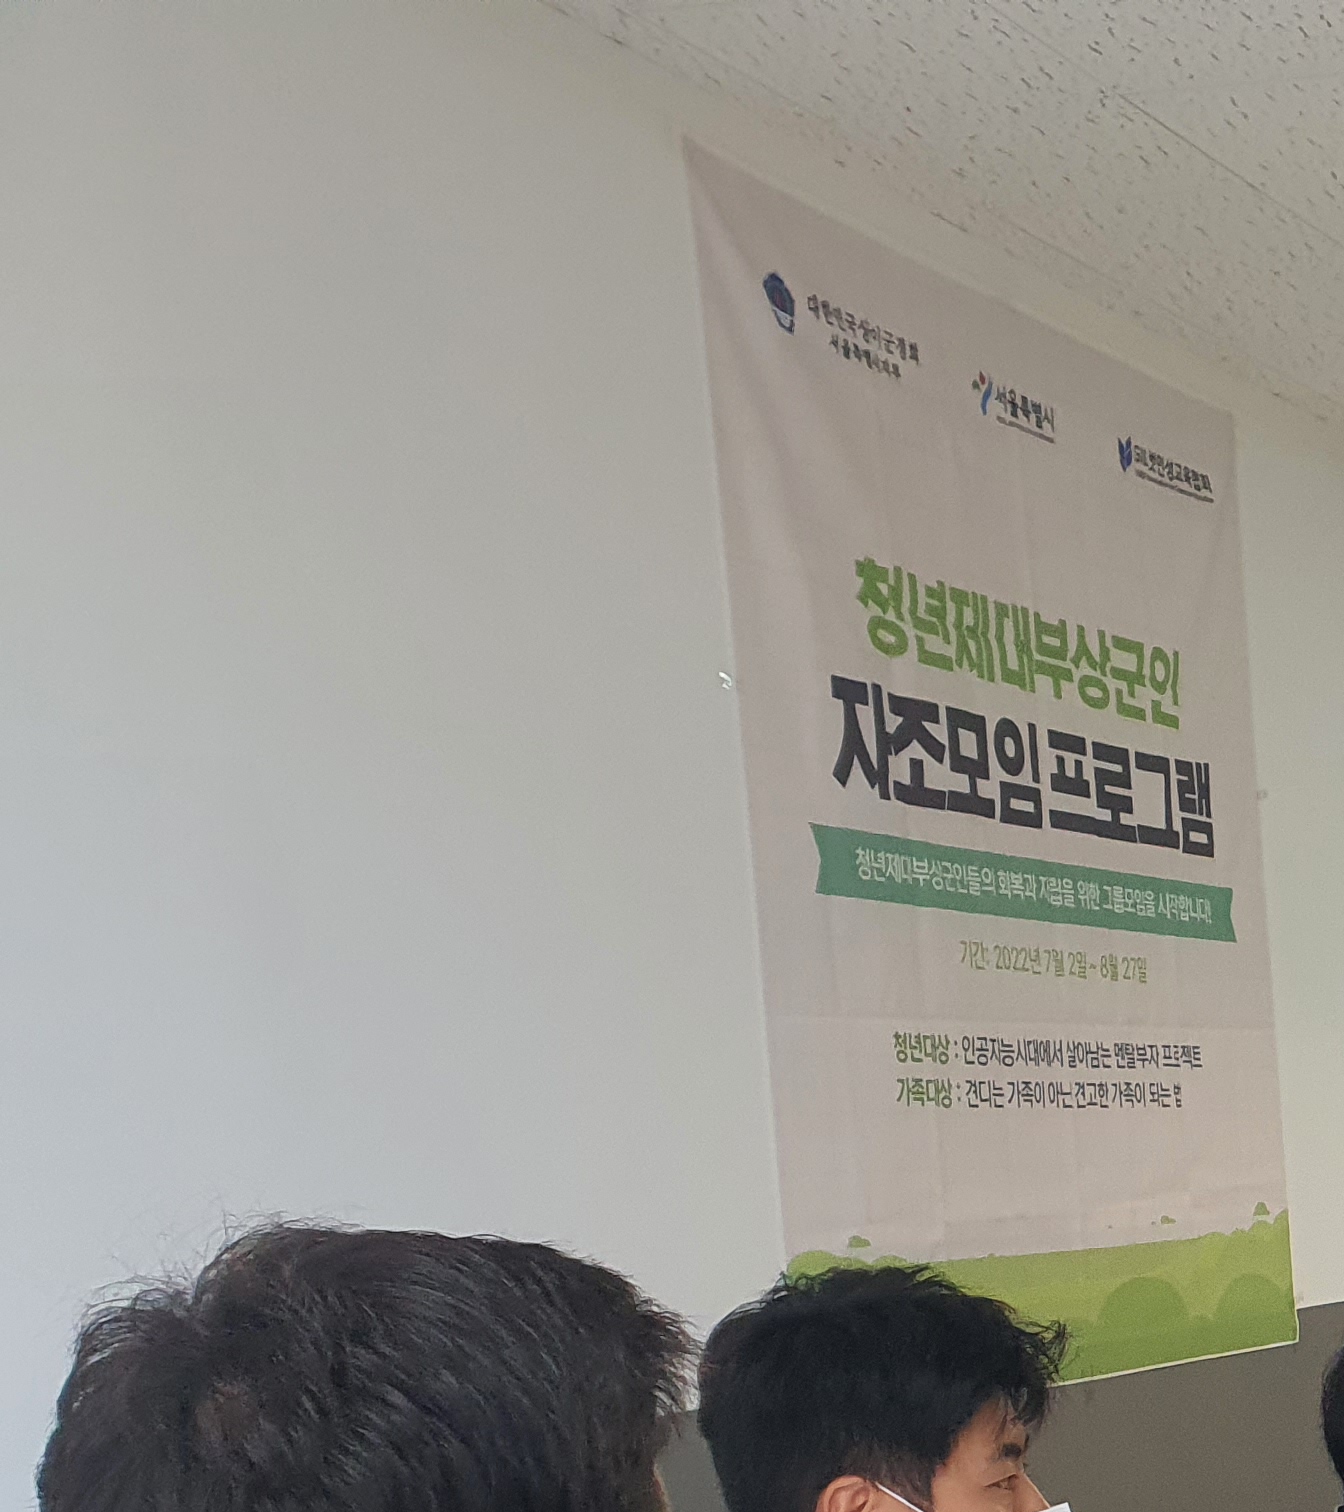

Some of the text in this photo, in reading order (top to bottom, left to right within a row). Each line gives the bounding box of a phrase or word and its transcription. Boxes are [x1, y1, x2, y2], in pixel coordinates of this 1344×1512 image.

[995, 385, 1055, 433] 서울특별시
[855, 556, 1180, 731] 청년제대부상군인
[830, 674, 1215, 858] 자조모임프로그램
[855, 846, 996, 896] 청년제대부상군인들의
[997, 869, 1037, 902] 회복과
[1039, 876, 1075, 908] 자립을
[1077, 880, 1100, 910] 위한
[1102, 885, 1155, 918] 그룹모임을
[994, 944, 1042, 976] 2022년
[1044, 949, 1065, 978] 7월
[1100, 953, 1119, 982] 8월
[1121, 956, 1148, 985] 27일
[893, 1031, 951, 1065] 청년대상
[961, 1035, 1064, 1068] 인공지능시대에서
[1066, 1040, 1112, 1069] 살아남는
[1113, 1042, 1160, 1069] 멘탈부자
[1161, 1044, 1203, 1070] 프로젝트
[896, 1077, 953, 1109] 가족대상
[965, 1079, 1005, 1109] 견디는
[1007, 1080, 1046, 1109] 가족이
[1047, 1081, 1074, 1109] 아닌
[1074, 1081, 1110, 1109] 견고한
[1111, 1081, 1147, 1109] 가족이
[1149, 1082, 1172, 1108] 되는
